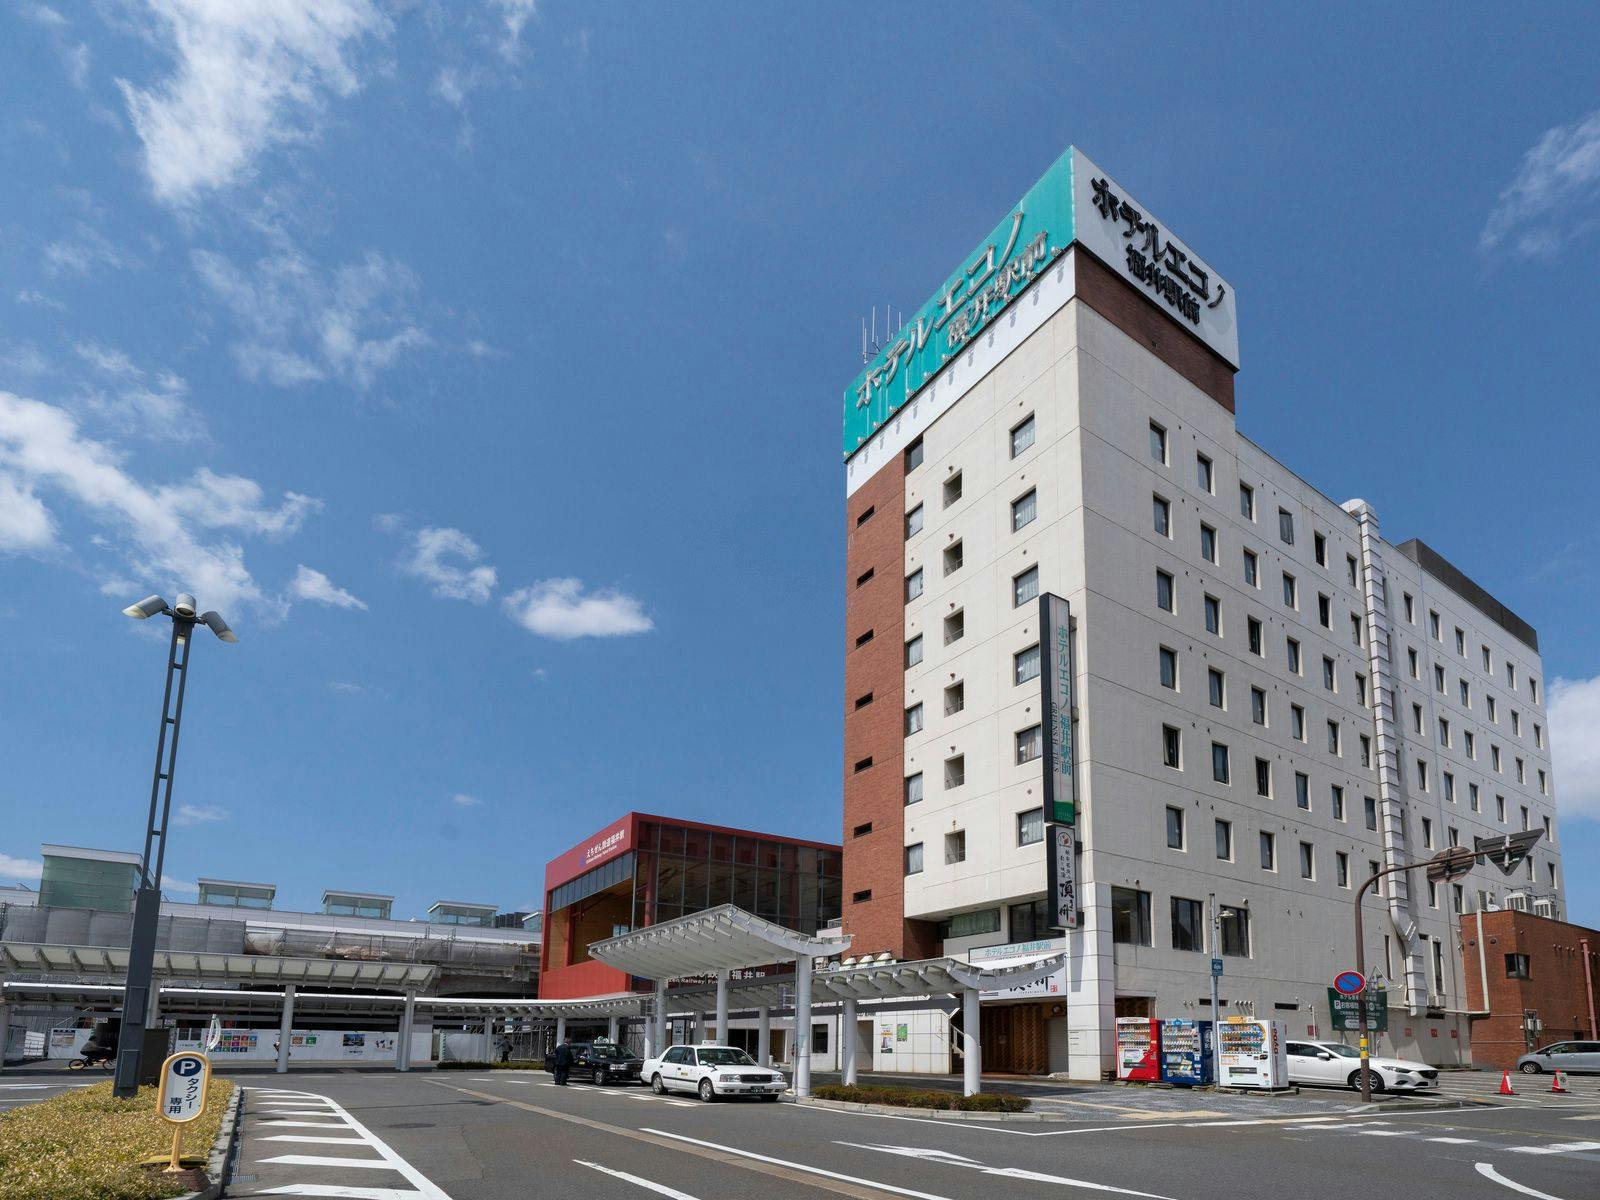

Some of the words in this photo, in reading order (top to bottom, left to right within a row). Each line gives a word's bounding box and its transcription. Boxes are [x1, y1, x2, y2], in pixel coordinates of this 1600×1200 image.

[1091, 178, 1226, 309] ホテルエコノ
[1126, 243, 1200, 325] 福井駅前
[856, 211, 1024, 408] ホテルエコノ
[948, 230, 1048, 349] 福井駅前
[169, 1097, 182, 1114] 専用
[180, 1061, 196, 1074] P
[186, 1078, 199, 1109] タクシー
